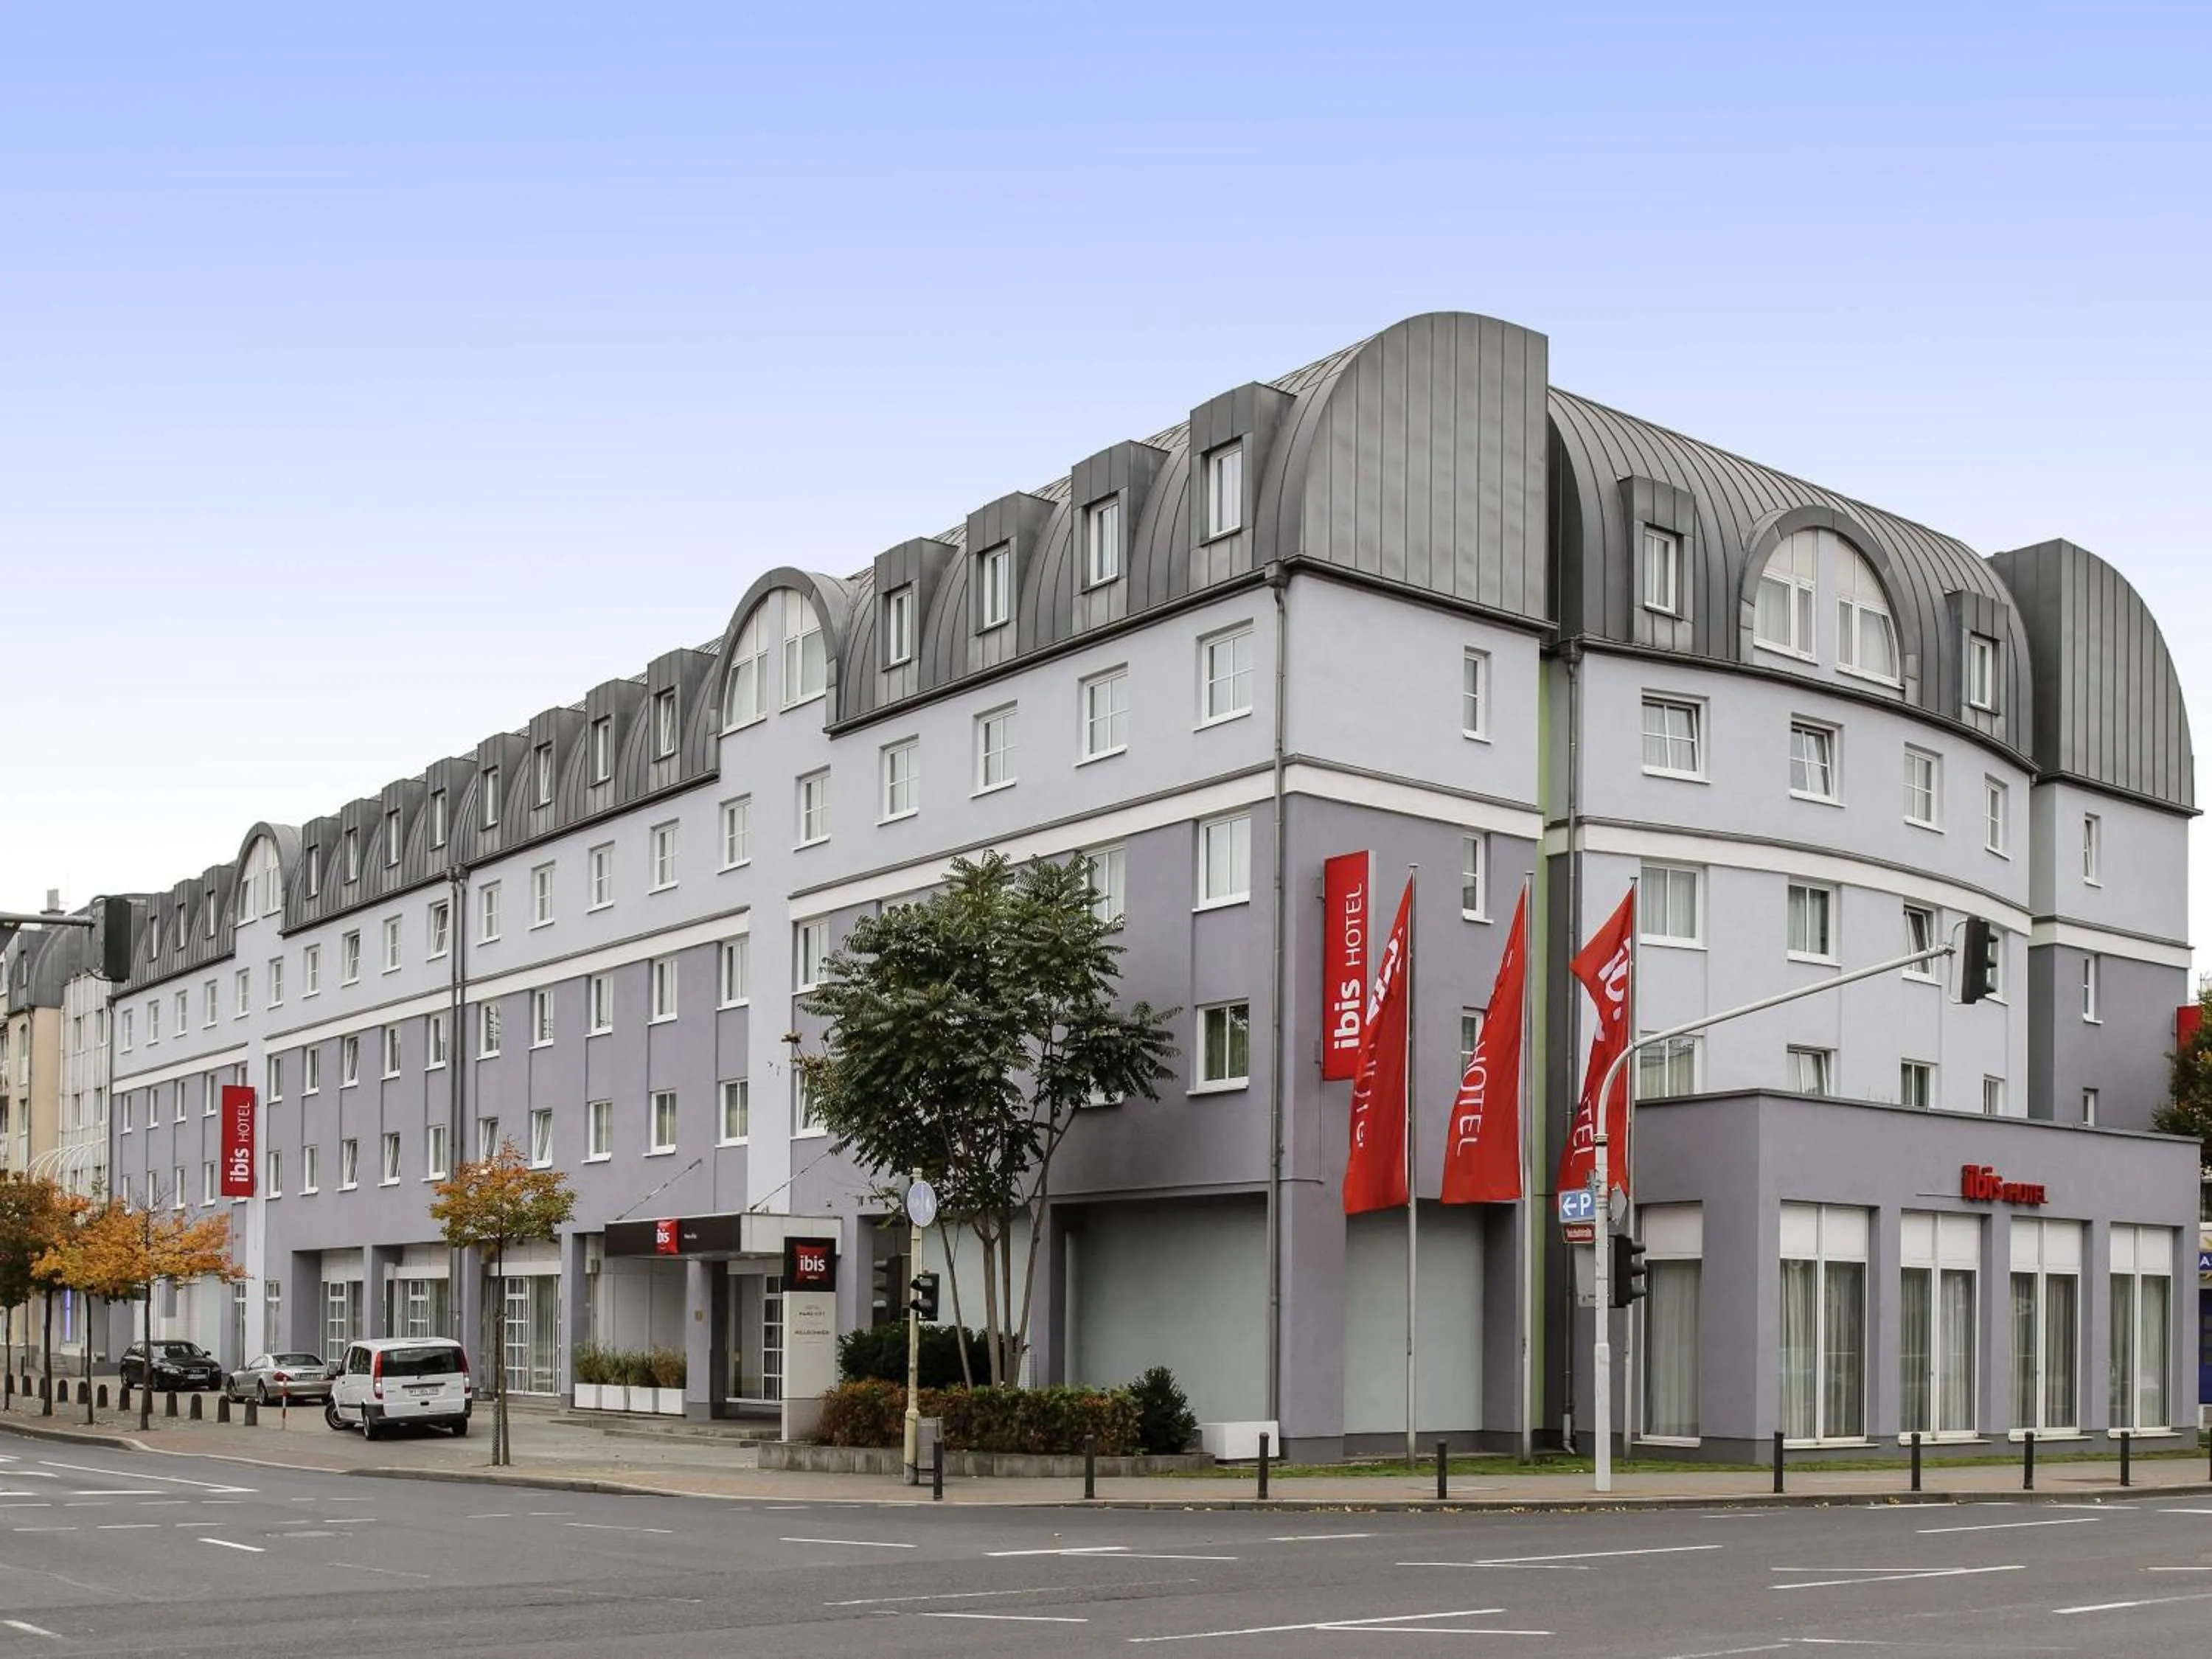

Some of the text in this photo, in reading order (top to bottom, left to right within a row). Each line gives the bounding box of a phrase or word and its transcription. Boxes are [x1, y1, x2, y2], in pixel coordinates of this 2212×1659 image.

[1334, 883, 1363, 1049] ibis HOTEL
[1456, 1040, 1488, 1157] HOTEL
[1570, 1093, 1594, 1167] TEL
[229, 1101, 250, 1182] ibis HOTEL
[1580, 1193, 1592, 1216] P
[800, 1255, 825, 1272] ibis
